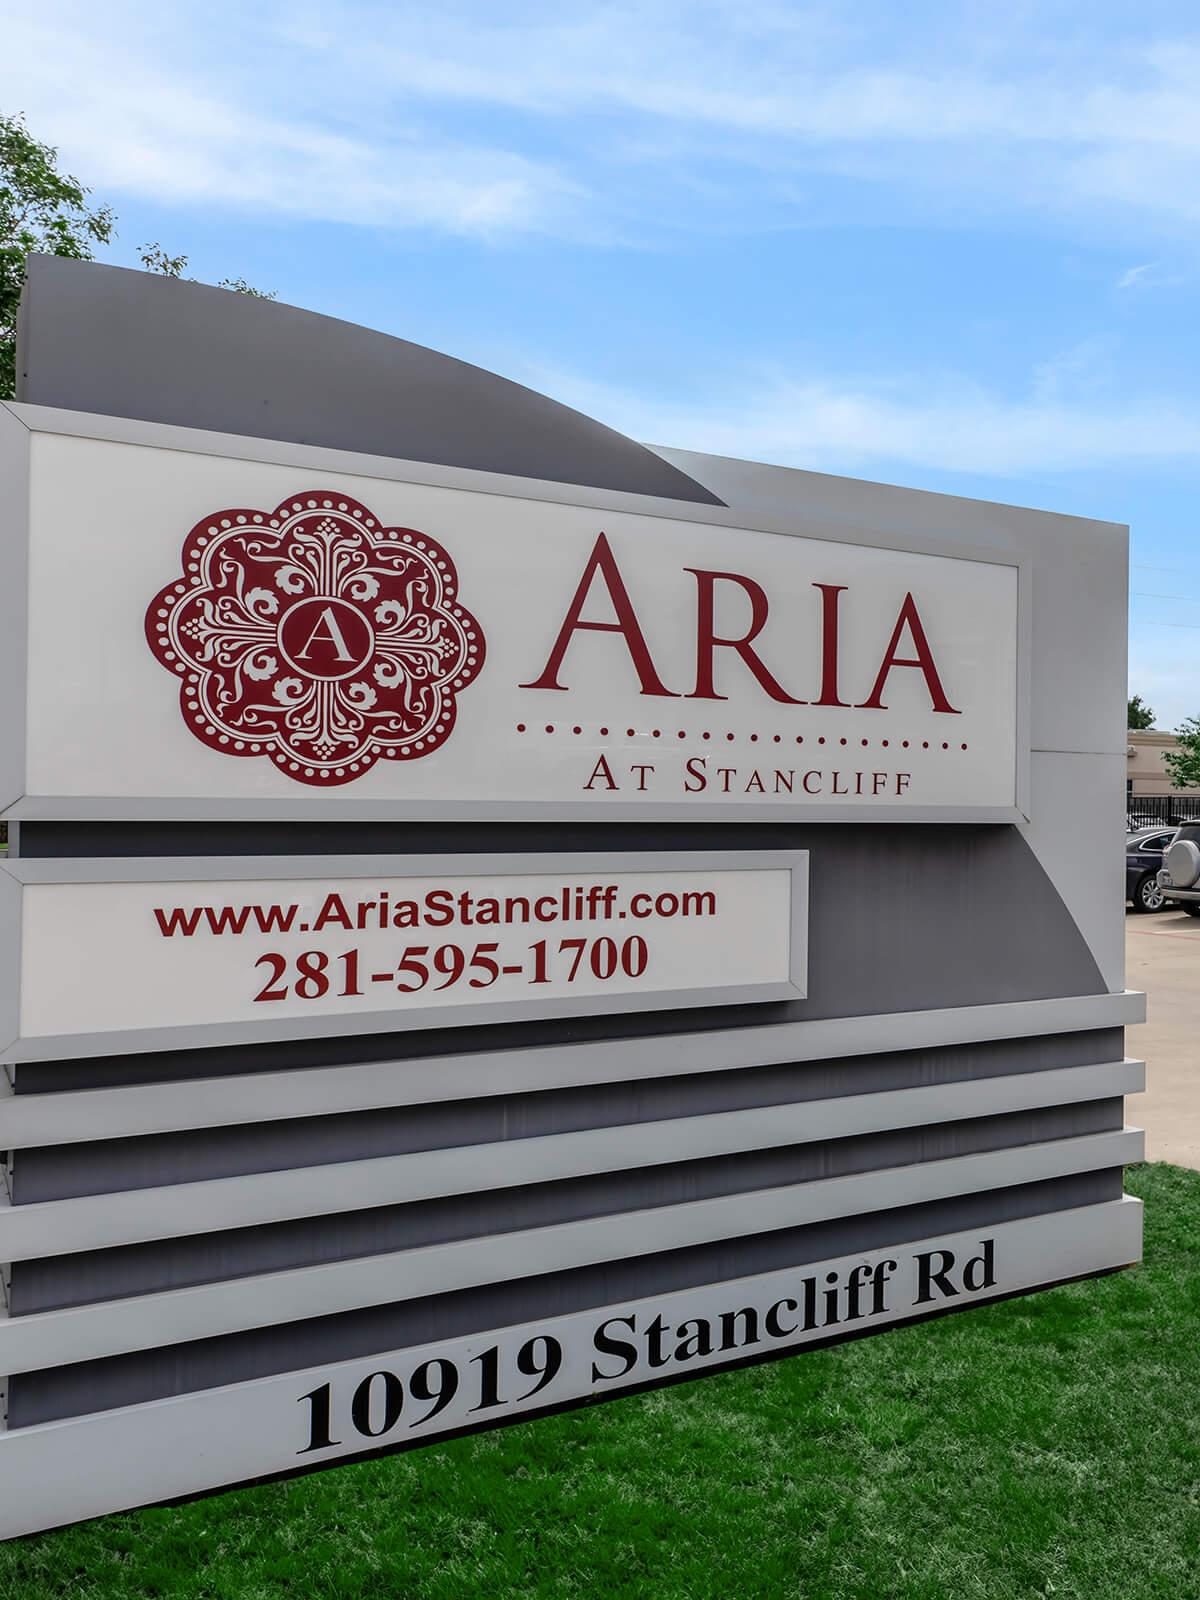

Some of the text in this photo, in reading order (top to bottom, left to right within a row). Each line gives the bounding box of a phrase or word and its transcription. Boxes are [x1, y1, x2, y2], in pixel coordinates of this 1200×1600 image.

[294, 606, 359, 662] A
[518, 531, 962, 714] ARIA
[154, 886, 717, 937] www.AriaStancliff.com
[253, 935, 649, 1003] 281-595-1700
[296, 1239, 998, 1455] 10919 Stancliff Rd
